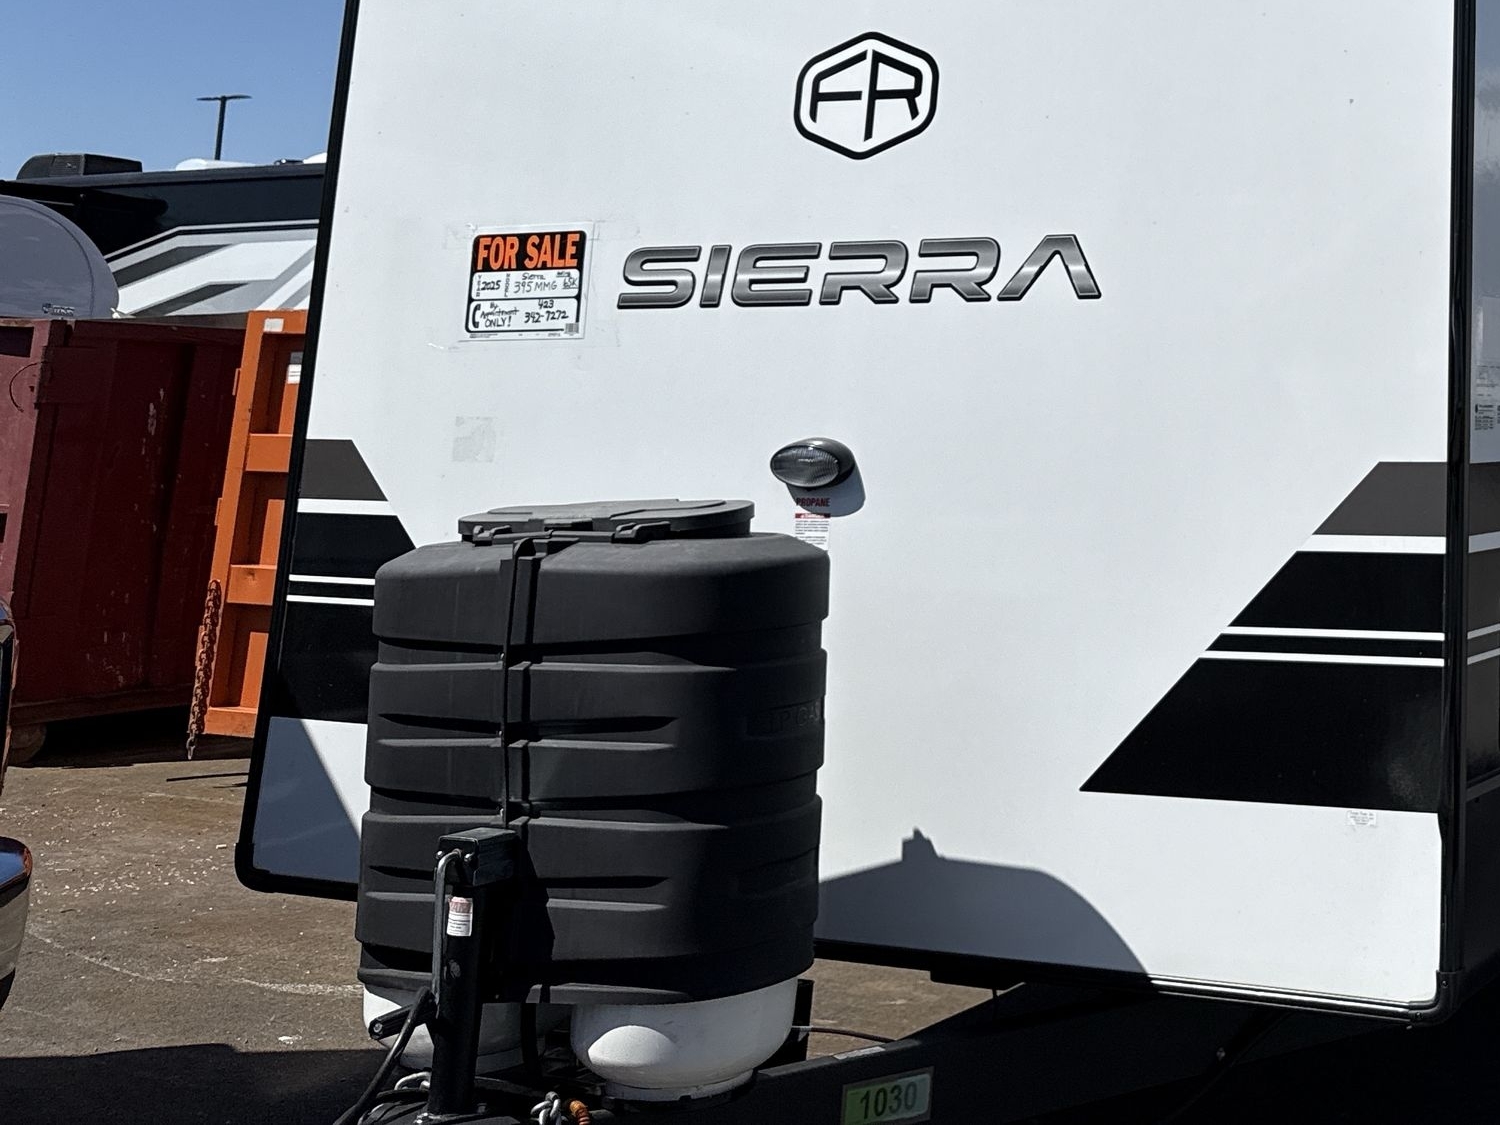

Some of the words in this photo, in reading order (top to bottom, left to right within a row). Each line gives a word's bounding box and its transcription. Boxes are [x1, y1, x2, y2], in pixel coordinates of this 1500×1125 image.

[477, 236, 519, 270] FOR
[524, 234, 580, 269] SALE
[616, 234, 1102, 309] SIERRA
[481, 279, 502, 291] 2025
[538, 299, 554, 310] 423
[796, 497, 831, 507] PROPANE
[860, 1081, 918, 1120] 1030
